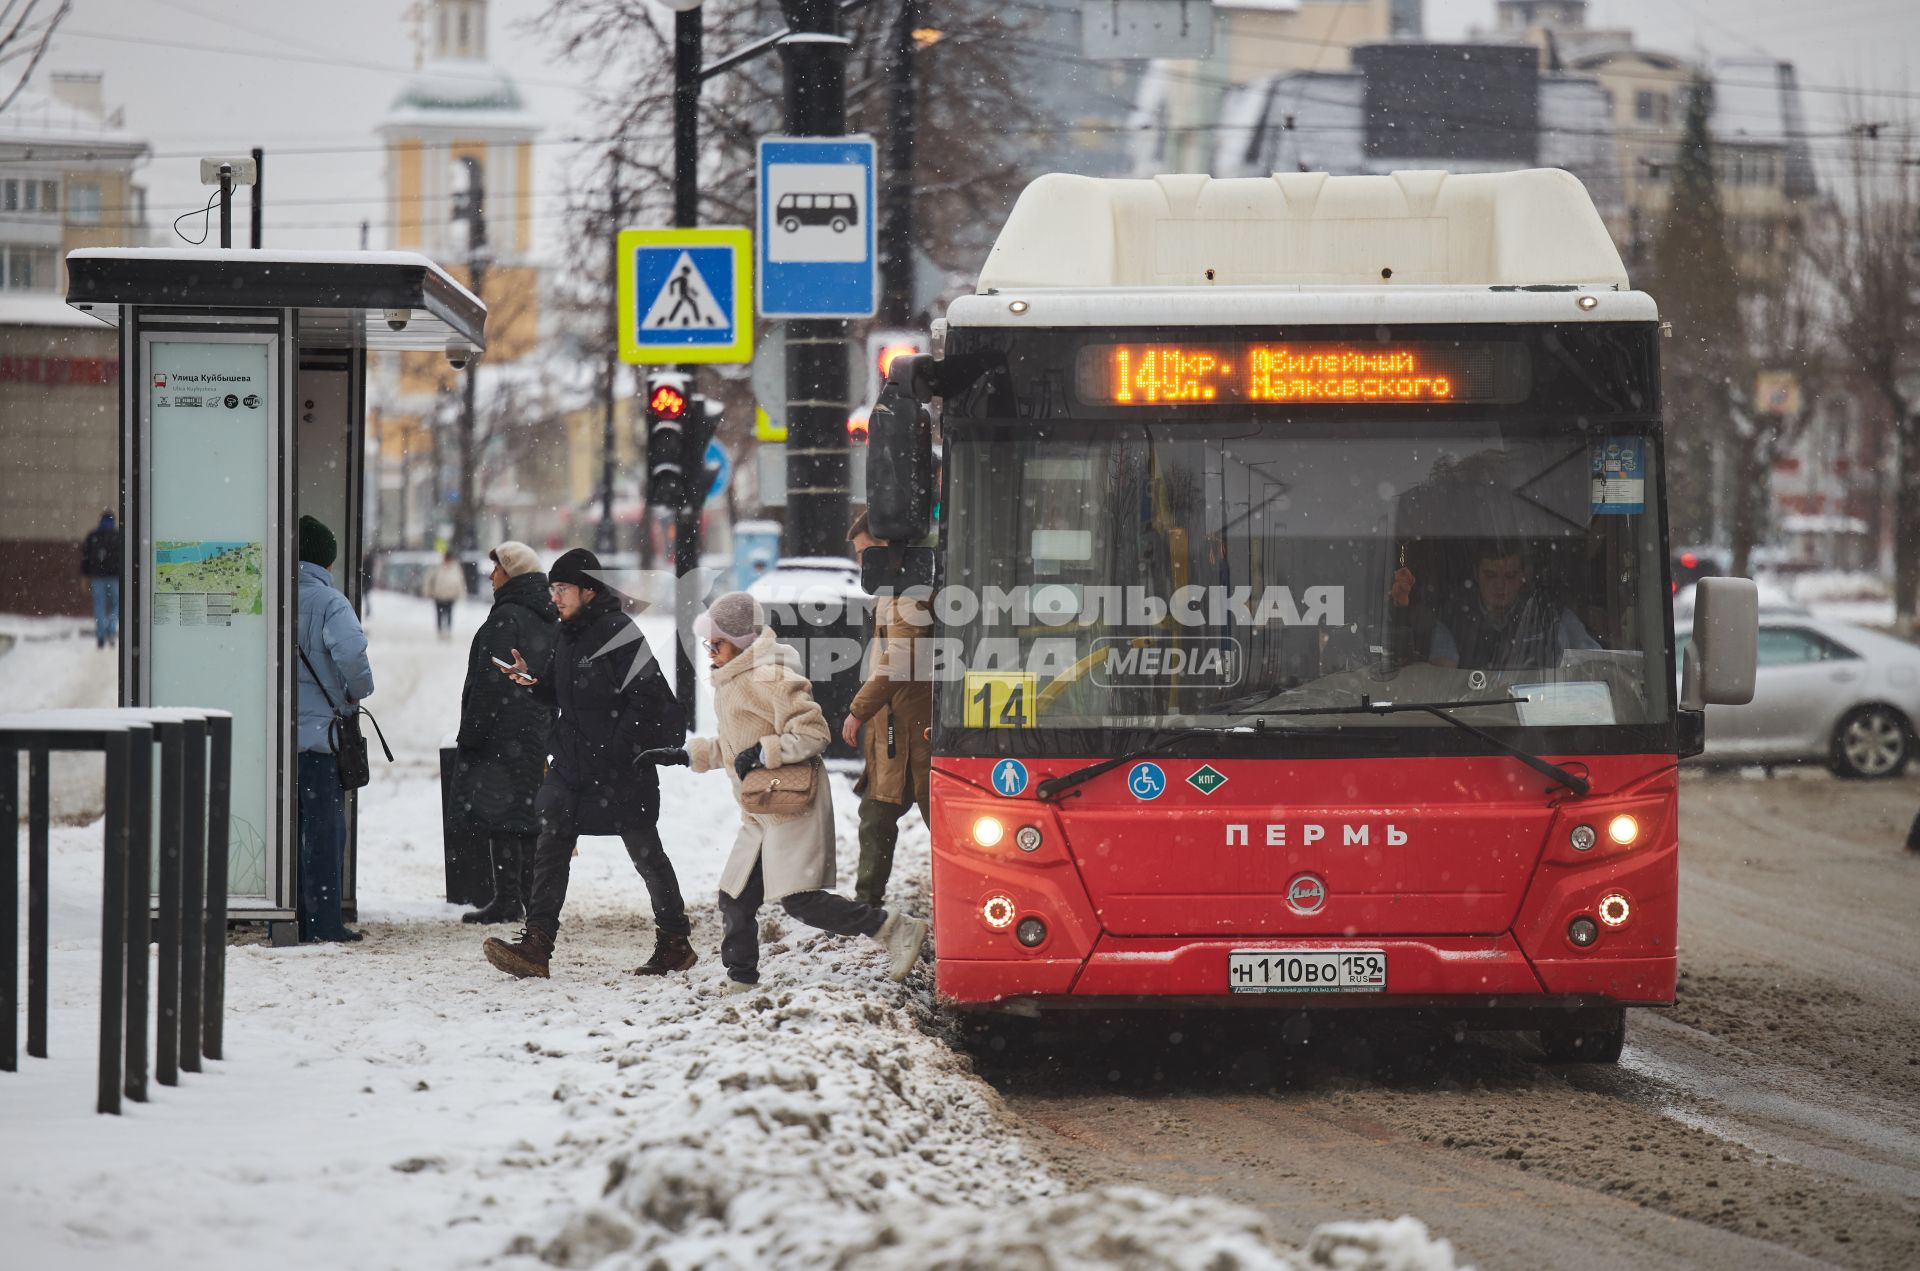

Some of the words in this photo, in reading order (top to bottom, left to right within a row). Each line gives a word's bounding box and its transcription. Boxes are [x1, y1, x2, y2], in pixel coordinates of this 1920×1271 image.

[172, 373, 199, 383] Улица
[201, 373, 251, 384] Куйбышева
[1118, 350, 1161, 401] 14
[1252, 374, 1450, 398] Маяковского
[973, 682, 1028, 728] 14
[1198, 775, 1216, 785] КПГ
[1226, 824, 1408, 847] ПЕРМЬ
[1341, 956, 1379, 976] 159
[1349, 975, 1369, 983] RUS
